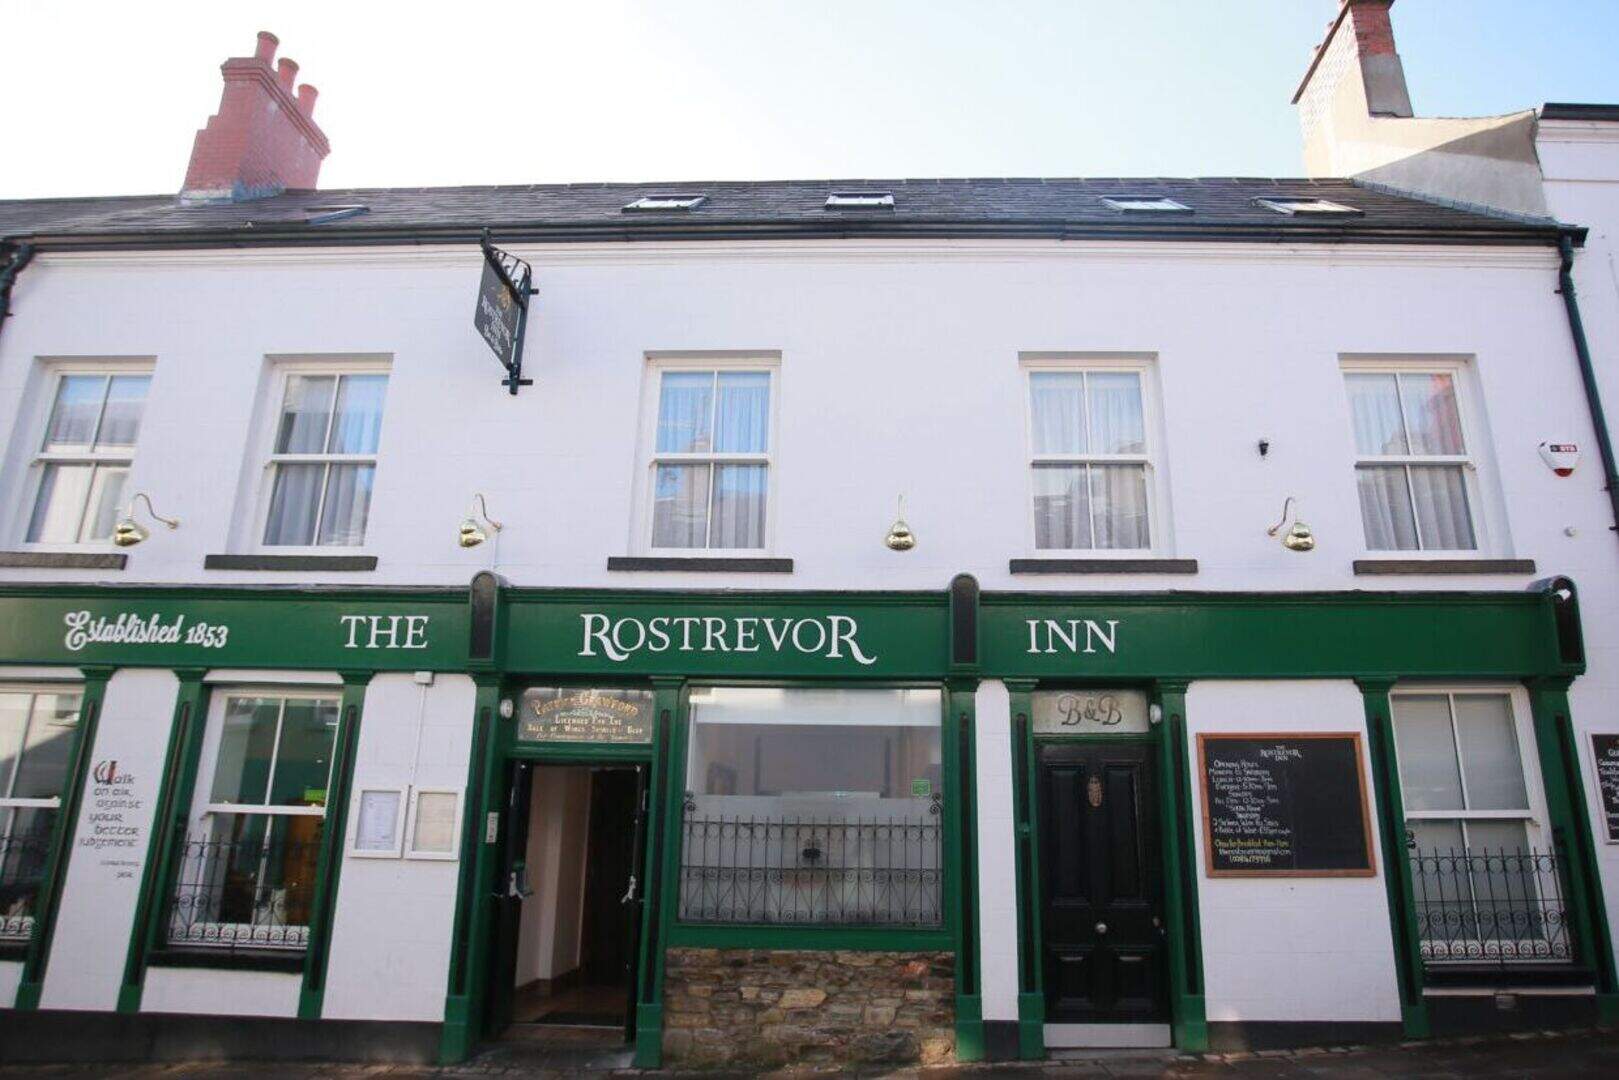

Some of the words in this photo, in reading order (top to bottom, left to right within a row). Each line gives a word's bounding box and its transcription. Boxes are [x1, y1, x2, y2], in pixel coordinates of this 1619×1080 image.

[65, 610, 185, 651] Established
[185, 622, 229, 649] 1853
[340, 615, 430, 649] THE
[578, 613, 877, 665] ROSTREVOR
[1025, 619, 1120, 653] INN
[1058, 693, 1122, 725] B&B
